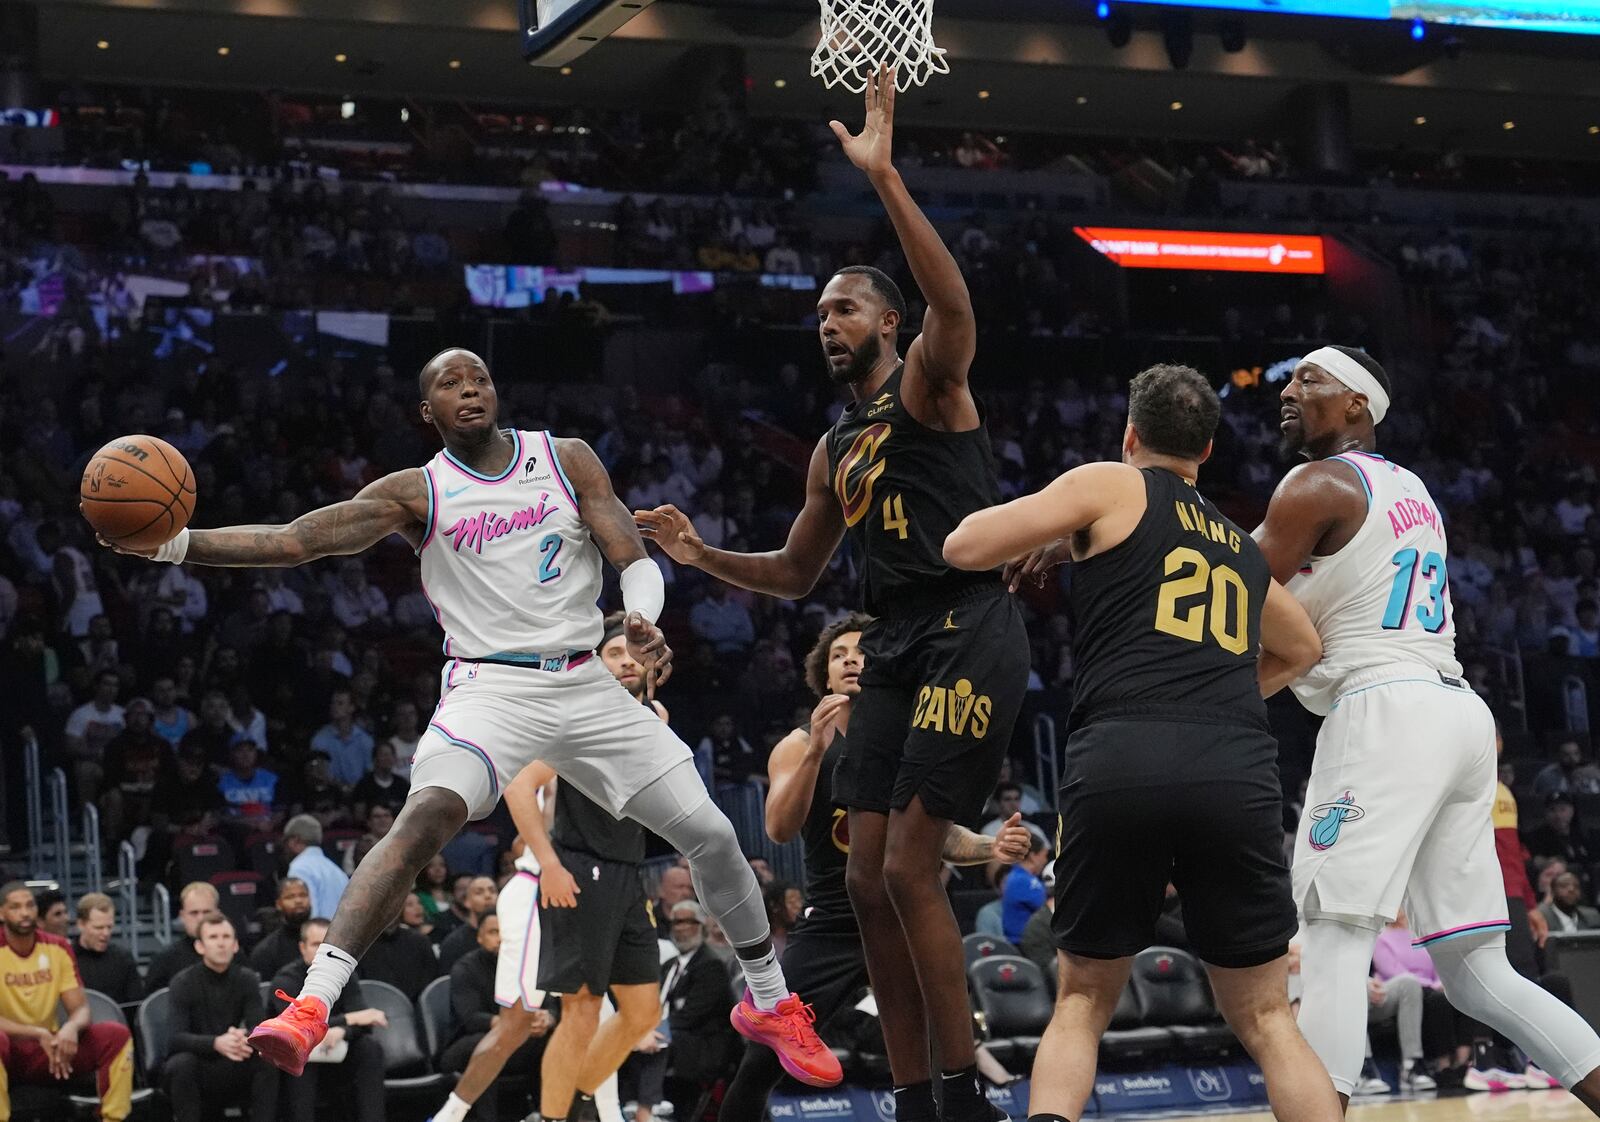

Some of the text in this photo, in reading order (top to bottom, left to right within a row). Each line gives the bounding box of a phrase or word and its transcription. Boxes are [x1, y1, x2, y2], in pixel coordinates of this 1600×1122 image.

[867, 402, 894, 417] CLIFFS
[518, 473, 551, 486] Robinhood
[442, 491, 559, 555] Miami
[882, 493, 909, 540] 4
[1175, 500, 1241, 554] NIANG
[538, 533, 564, 585] 2
[1154, 546, 1249, 656] 20
[1381, 547, 1448, 635] 13
[912, 678, 993, 739] CAVS
